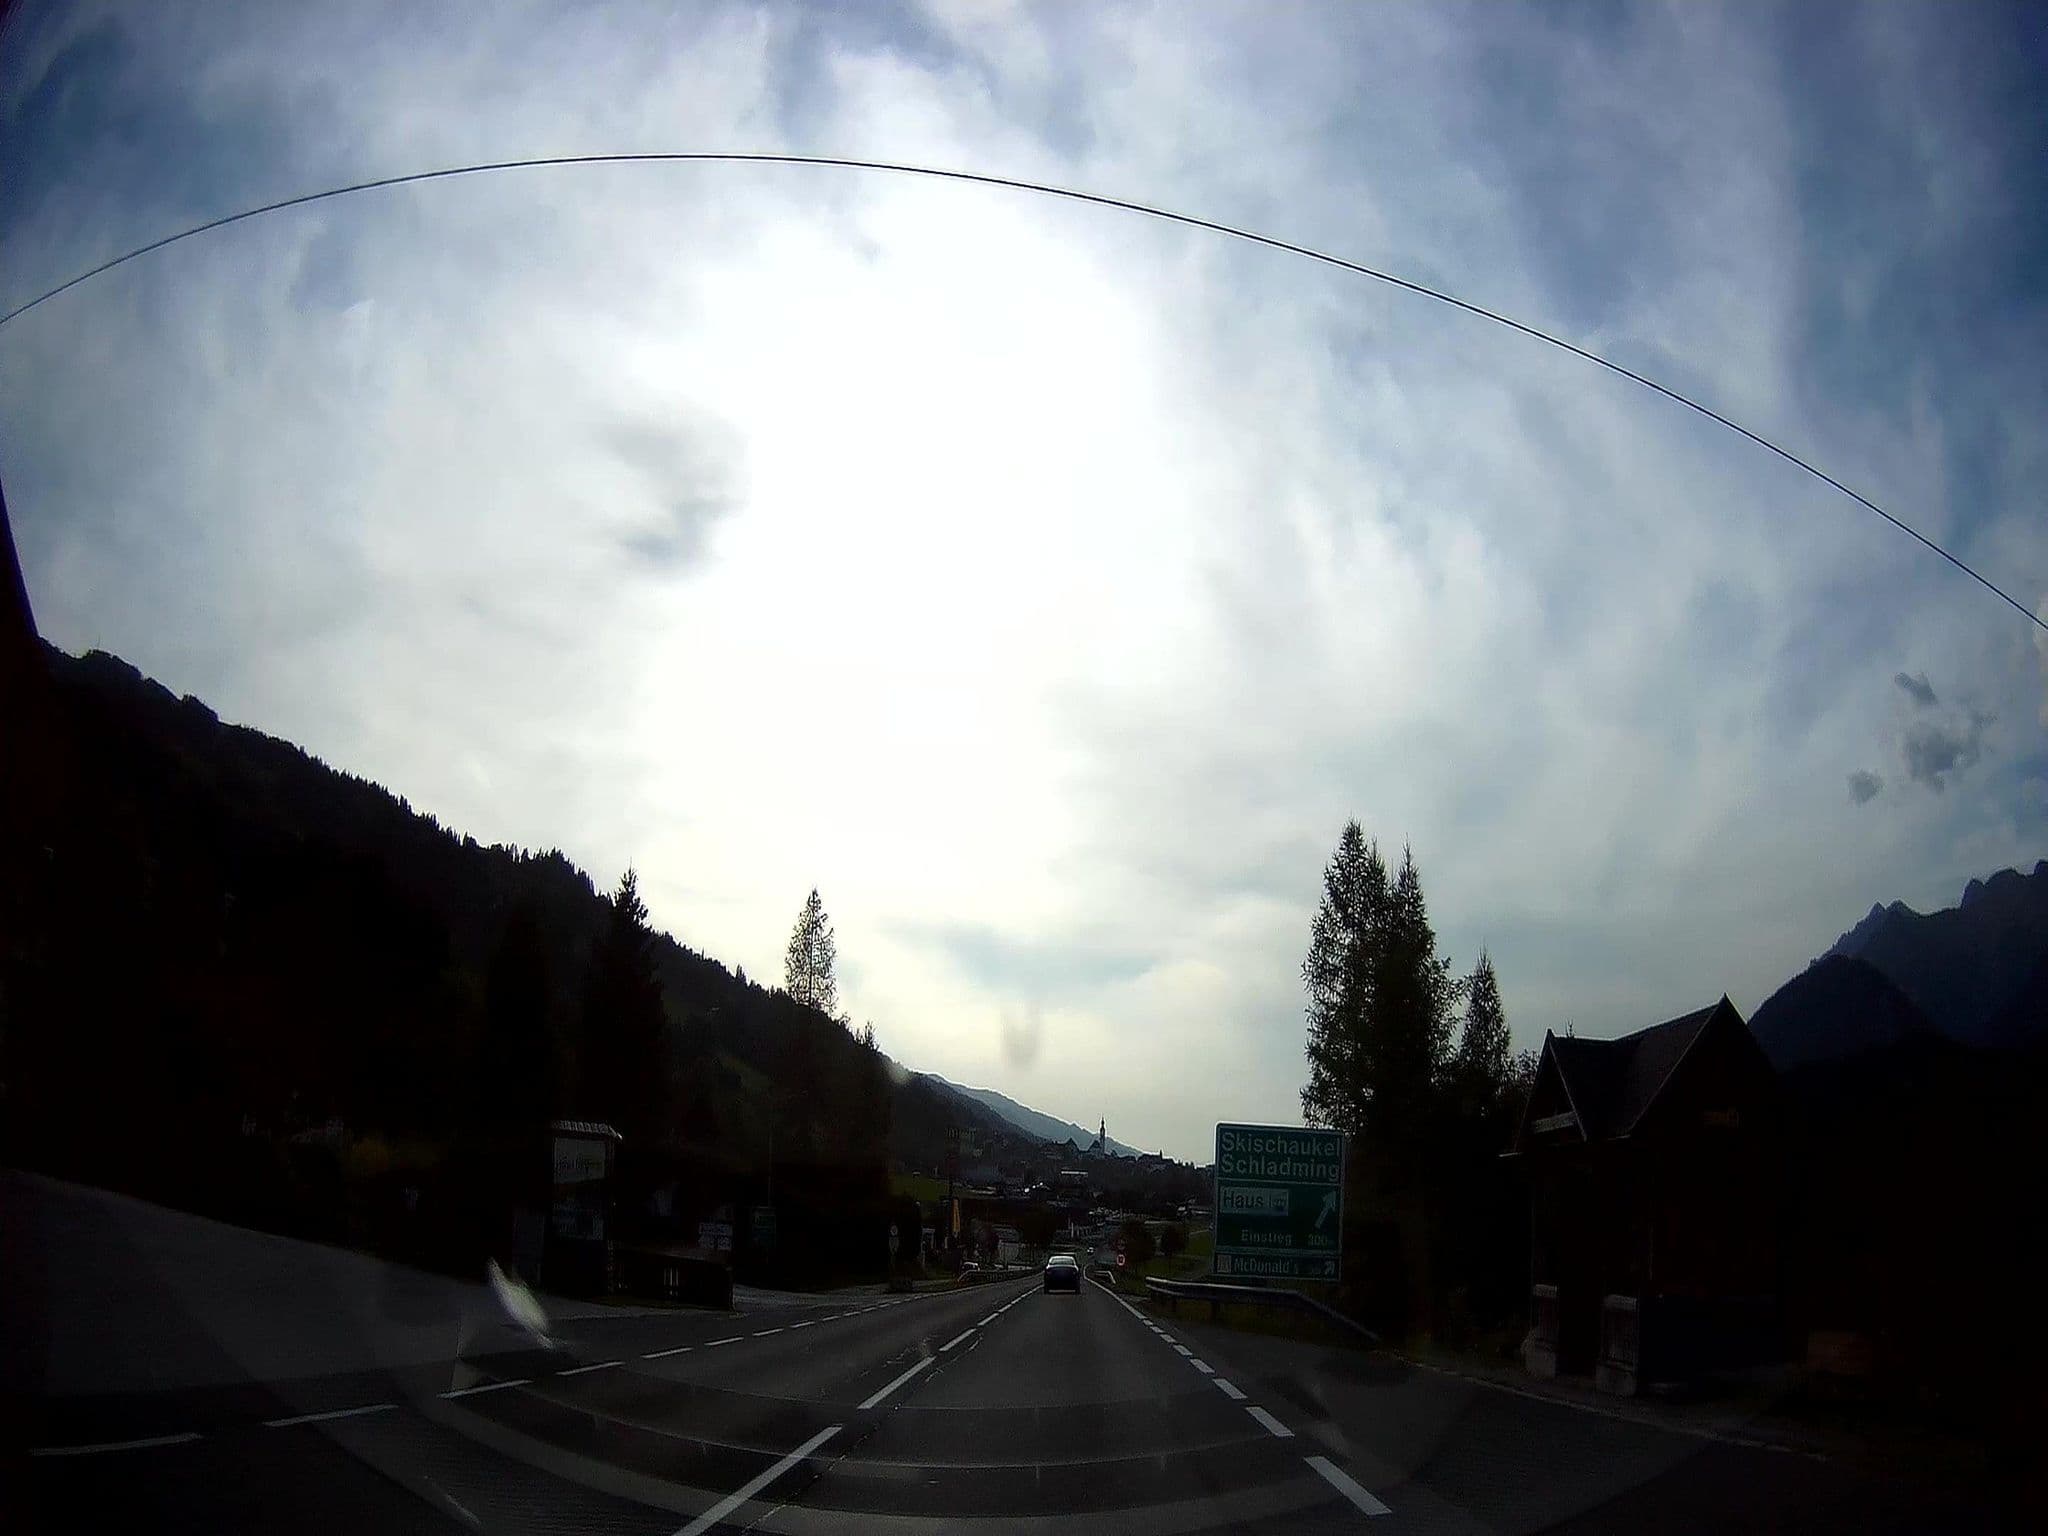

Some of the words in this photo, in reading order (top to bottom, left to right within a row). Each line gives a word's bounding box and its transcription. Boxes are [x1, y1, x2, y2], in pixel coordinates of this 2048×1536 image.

[1221, 1132, 1340, 1157] Skischaukel
[1221, 1154, 1340, 1181] Schladming
[1223, 1190, 1264, 1208] Haus
